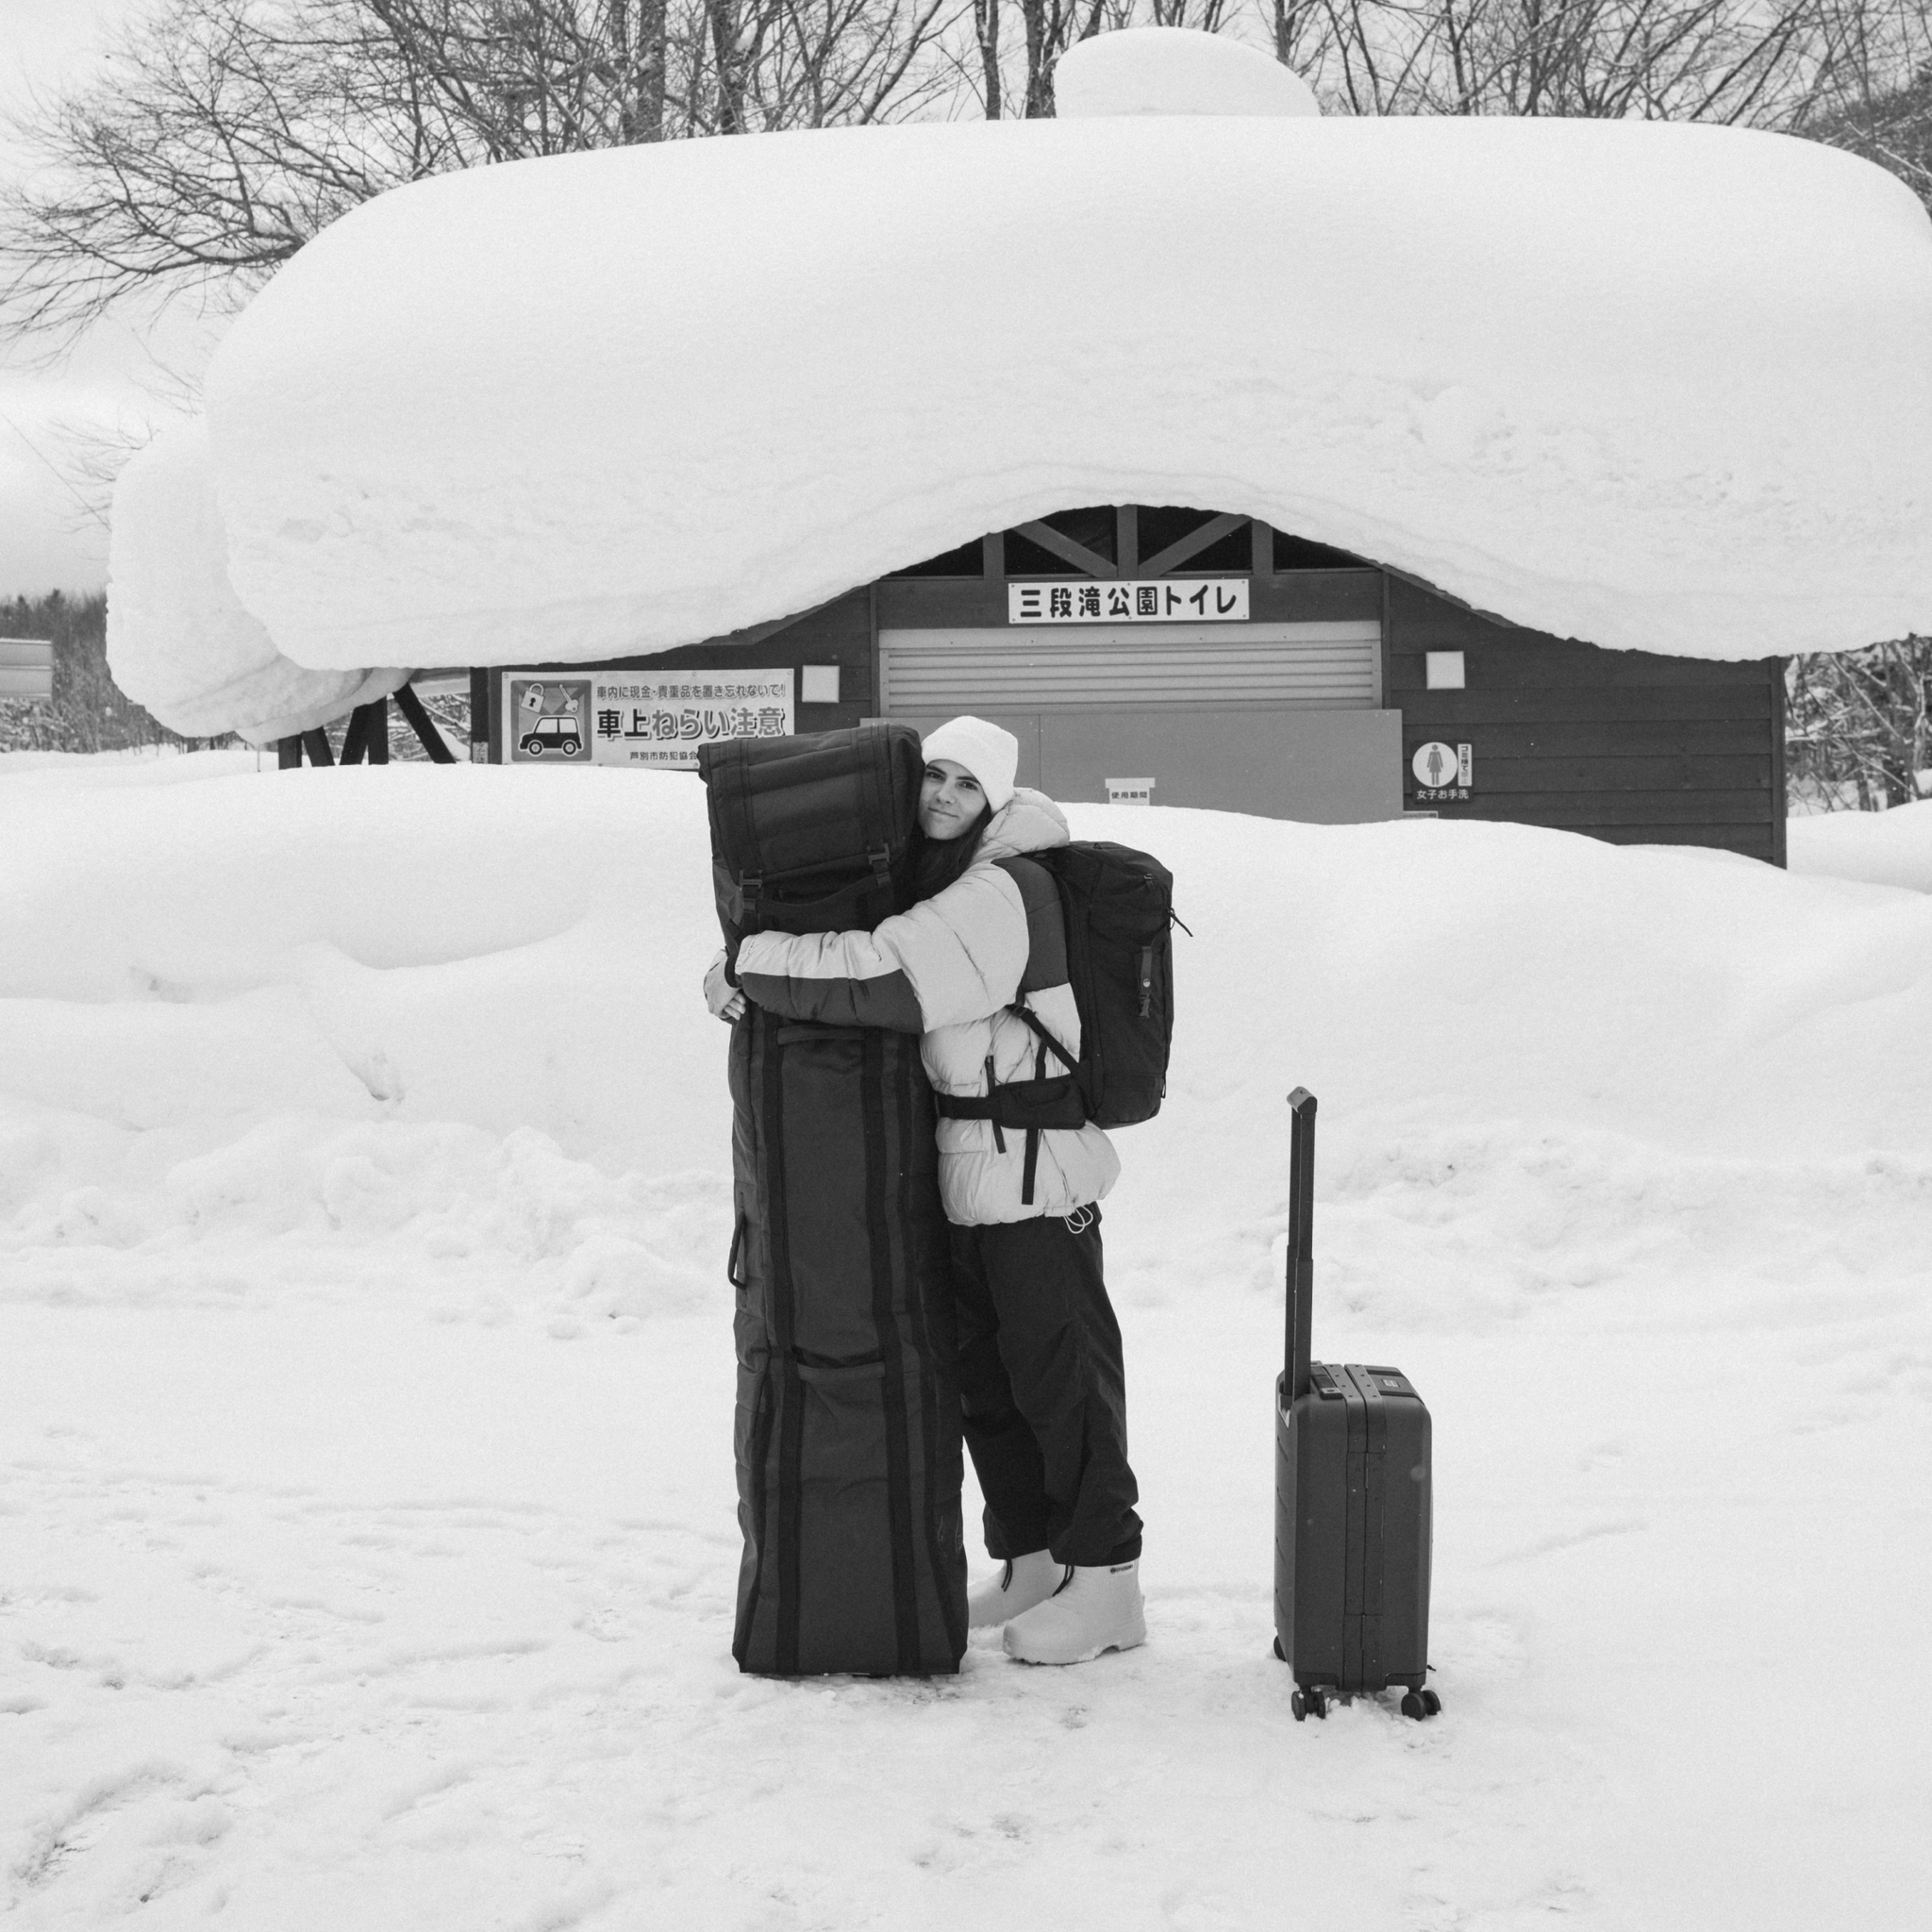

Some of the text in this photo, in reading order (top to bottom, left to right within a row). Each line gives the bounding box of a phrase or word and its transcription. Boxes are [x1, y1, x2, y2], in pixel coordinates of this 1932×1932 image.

[1020, 584, 1237, 618] 三段滝公園トイレ
[596, 707, 783, 739] 車上ねらい注意
[630, 750, 697, 760] 芦別市防犯協会
[1111, 791, 1148, 799] 使用期間
[1416, 789, 1469, 800] 女子お手洗
